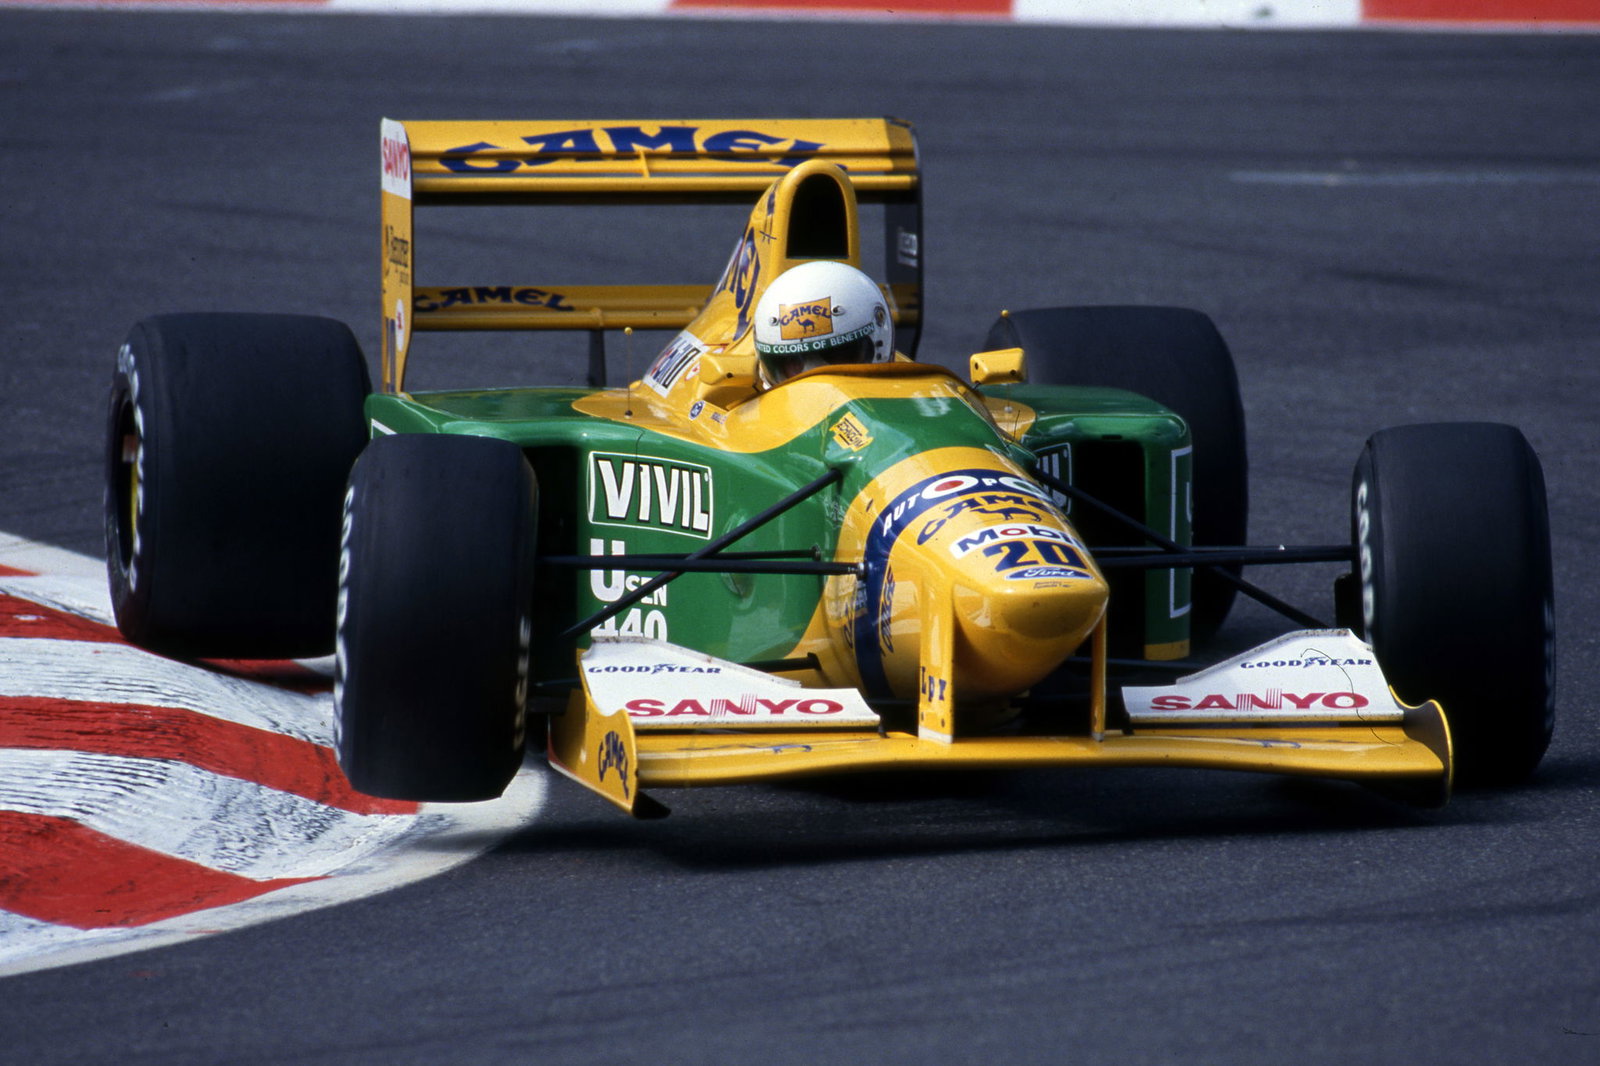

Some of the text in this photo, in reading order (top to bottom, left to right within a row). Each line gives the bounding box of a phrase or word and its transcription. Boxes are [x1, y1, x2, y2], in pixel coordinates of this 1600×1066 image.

[414, 286, 575, 312] CAMEL
[780, 305, 832, 326] CAMEL
[772, 342, 809, 354] COLORS
[812, 341, 827, 350] OF
[830, 324, 876, 346] BENETTON
[596, 459, 709, 532] VIVIL
[982, 540, 1089, 573] 20
[1023, 567, 1075, 577] Ford
[588, 664, 721, 676] GOODYEAR
[1240, 657, 1372, 669] GOODYEAR
[624, 693, 844, 717] SANYO
[1151, 688, 1369, 712] SANYO
